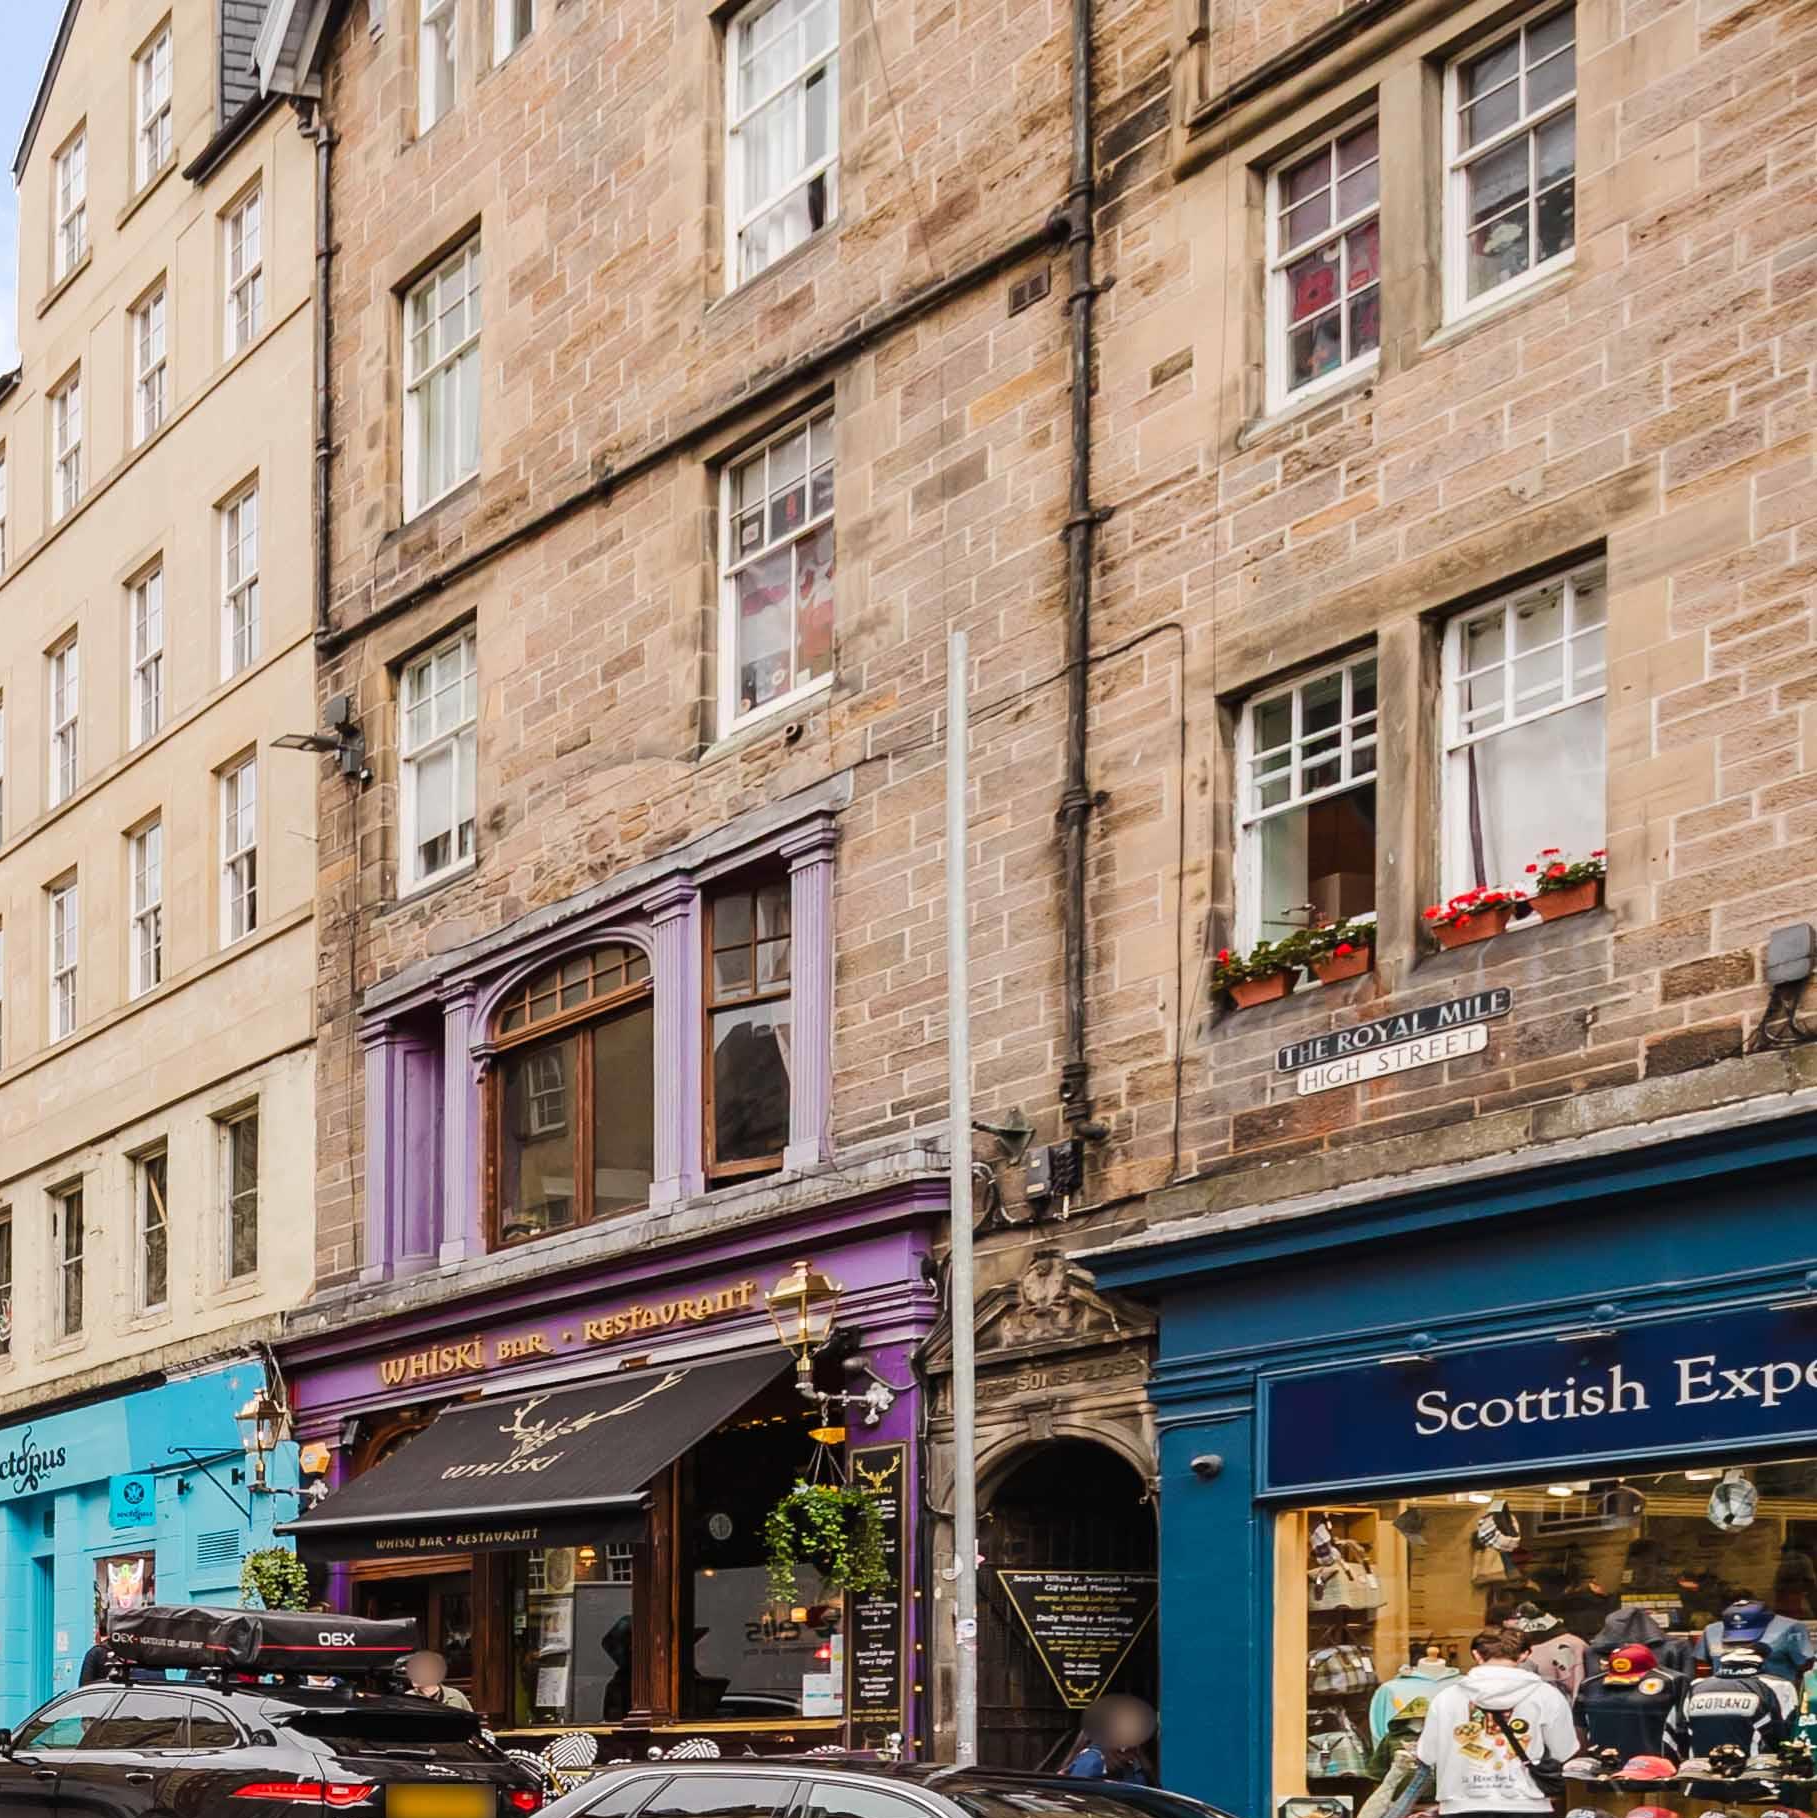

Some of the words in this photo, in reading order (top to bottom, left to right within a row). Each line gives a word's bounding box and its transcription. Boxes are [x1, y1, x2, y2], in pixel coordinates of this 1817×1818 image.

[1281, 1041, 1329, 1067] THE
[1337, 1016, 1426, 1053] ROYAL
[1437, 989, 1507, 1026] MILE
[1303, 1059, 1360, 1091] HIGH
[1377, 1027, 1478, 1072] STREET
[380, 1334, 485, 1386] WHISKI
[496, 1334, 554, 1361] BAR
[1415, 1364, 1651, 1436] Scottish
[441, 1450, 566, 1481] WHISKI
[375, 1536, 416, 1550] WHISKI
[419, 1535, 445, 1548] BAR
[318, 1632, 356, 1647] OEX
[1689, 1697, 1752, 1712] SCOTLAND
